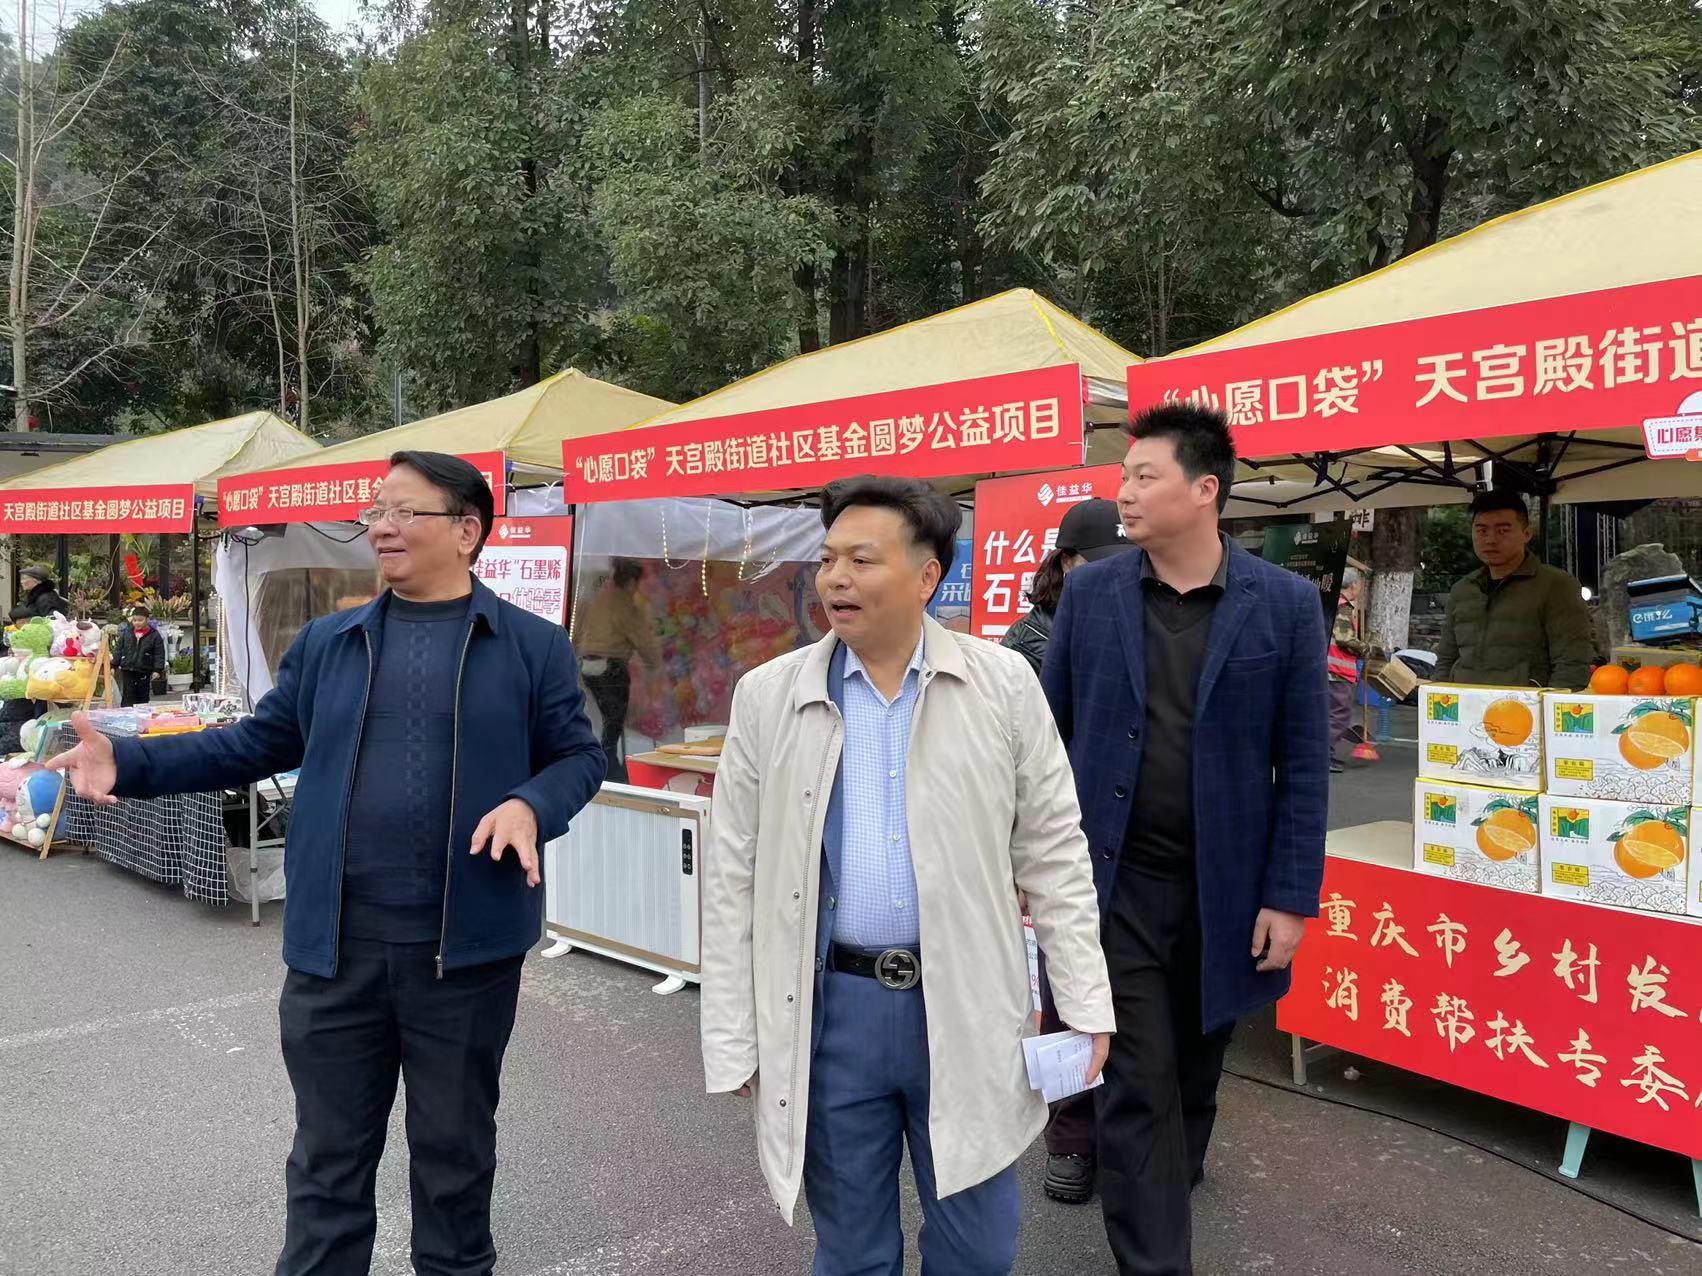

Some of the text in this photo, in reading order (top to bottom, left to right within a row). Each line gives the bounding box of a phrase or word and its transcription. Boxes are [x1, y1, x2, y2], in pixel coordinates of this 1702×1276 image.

[575, 397, 1059, 484] “心愿口袋” 天宫殿街道社区基金圆梦公益项目
[4, 498, 185, 521] 天宫殿街道社区基金圆梦公益项目
[1056, 482, 1093, 496] 佳益华
[1319, 892, 1702, 1018] 重庆市乡村发
[1321, 965, 1702, 1111] 消费帮扶专委
